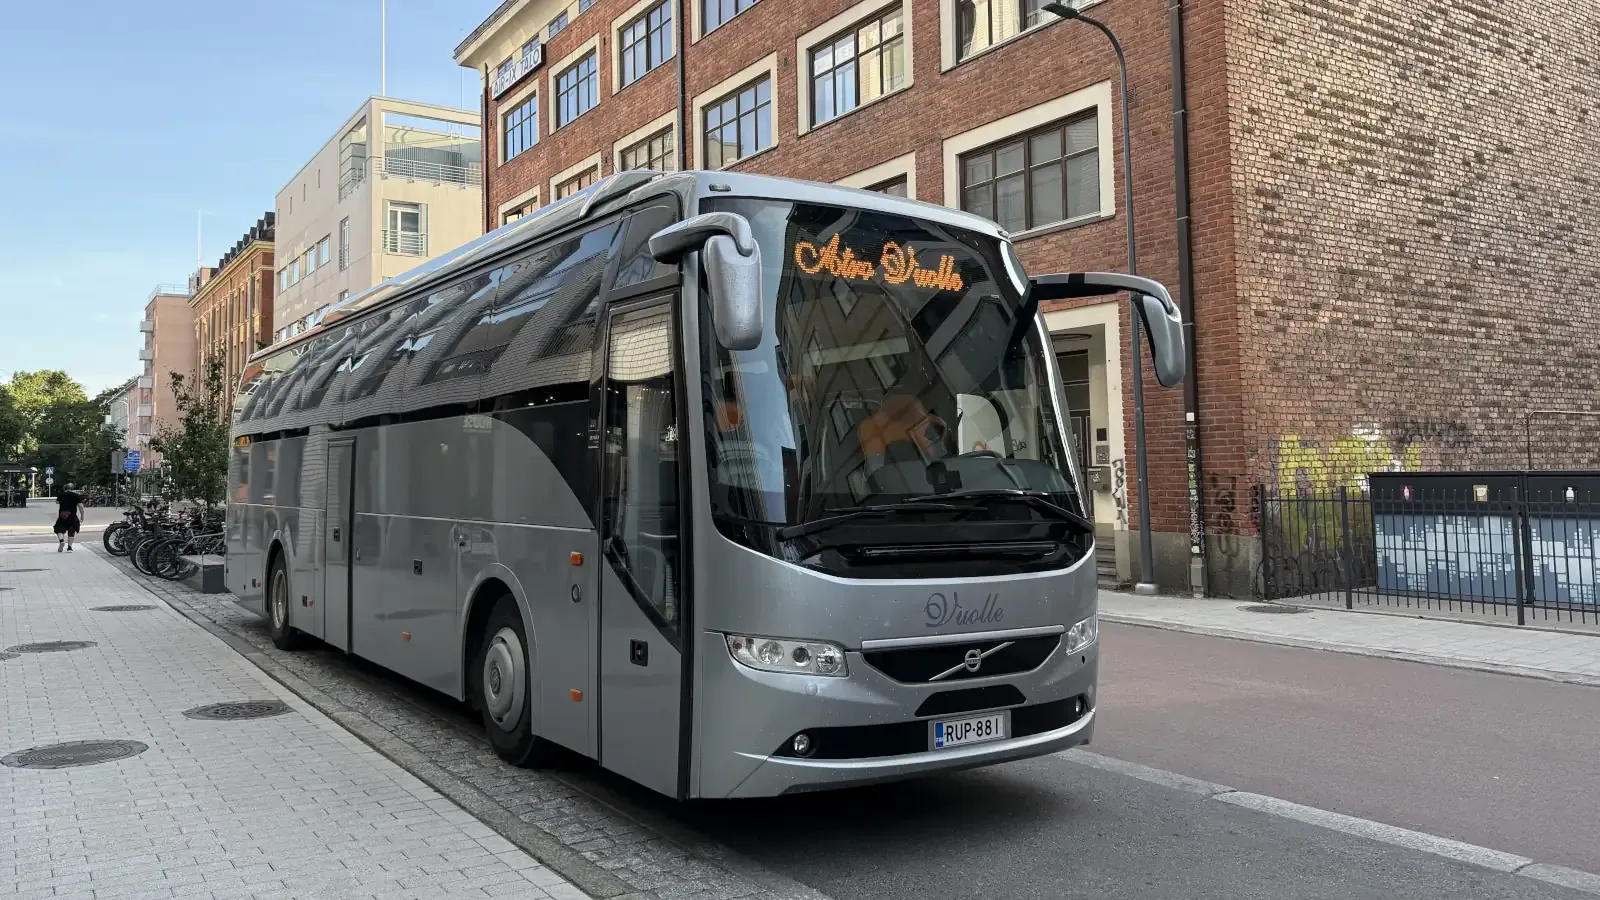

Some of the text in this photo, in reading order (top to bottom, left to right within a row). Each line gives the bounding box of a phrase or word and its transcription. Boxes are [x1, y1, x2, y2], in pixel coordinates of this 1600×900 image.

[493, 48, 540, 97] AIR-IX TALO
[880, 241, 963, 291] Vuolle
[923, 591, 1004, 627] Vuolle
[945, 717, 999, 743] RUP-881
